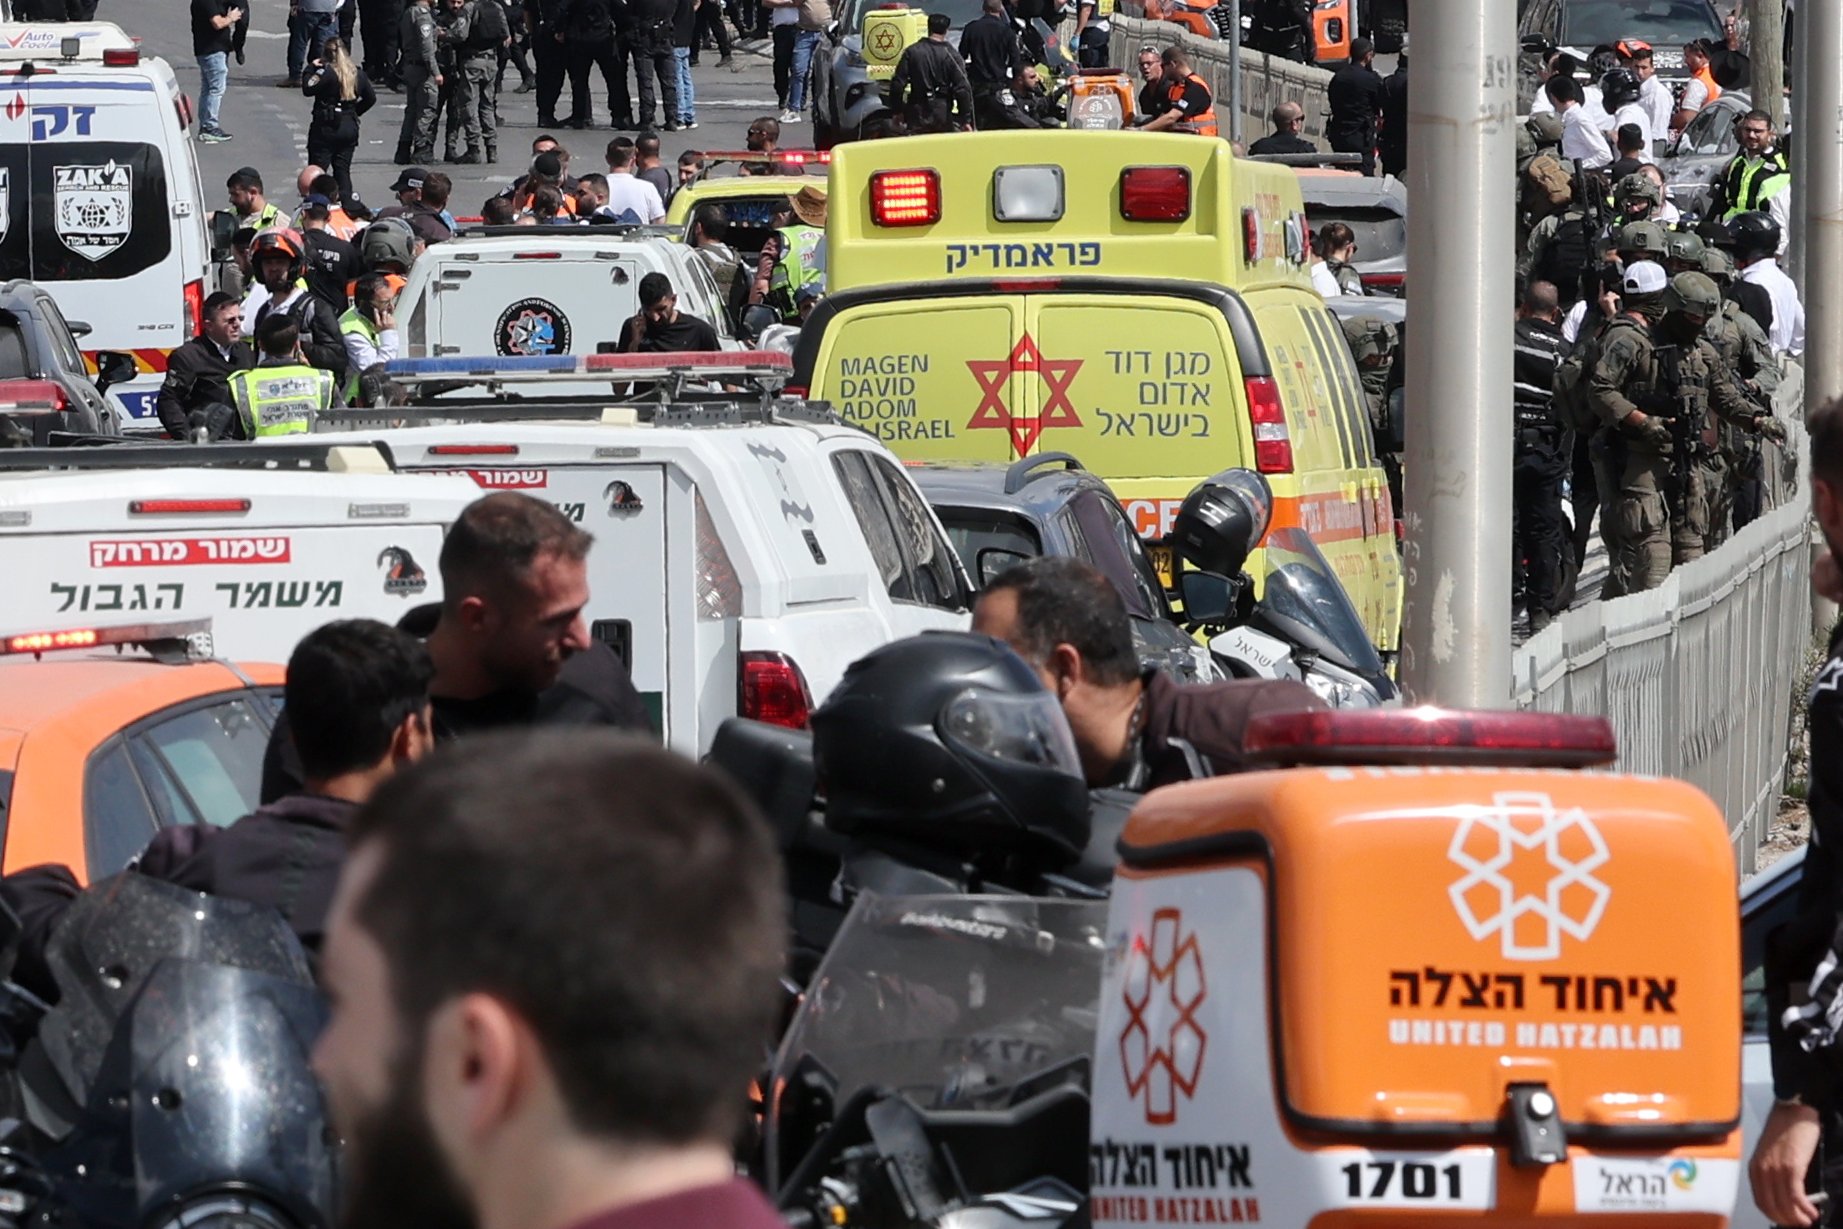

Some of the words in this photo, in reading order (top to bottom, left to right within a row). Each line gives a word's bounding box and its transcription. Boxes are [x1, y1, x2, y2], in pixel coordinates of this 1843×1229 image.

[19, 40, 50, 49] Cool
[24, 31, 54, 41] Auto
[946, 242, 1101, 273] פראמדיק
[841, 354, 928, 376] MAGEN
[1104, 350, 1152, 374] דוד
[1165, 351, 1210, 379] מגן
[840, 377, 915, 399] DAVID
[1139, 382, 1210, 406] אדום
[141, 396, 158, 417] 5
[841, 399, 916, 420] ADOM
[1095, 408, 1210, 437] בישראל
[477, 471, 544, 485] שמור
[92, 540, 189, 566] מרחק
[197, 537, 286, 559] שמור
[50, 581, 185, 613] הגבול
[215, 580, 344, 608] משמר
[1389, 967, 1524, 1009] הצלה
[1539, 975, 1678, 1013] איחוד
[1388, 1019, 1506, 1046] UNITED
[1516, 1023, 1682, 1050] HATZALAH
[1091, 1137, 1157, 1187] הצלה
[1164, 1143, 1253, 1190] איחוד
[1341, 1160, 1462, 1199] 1701
[1599, 1167, 1666, 1196] הראל
[1091, 1196, 1147, 1222] UNITED
[1154, 1196, 1261, 1223] HATZALAH
